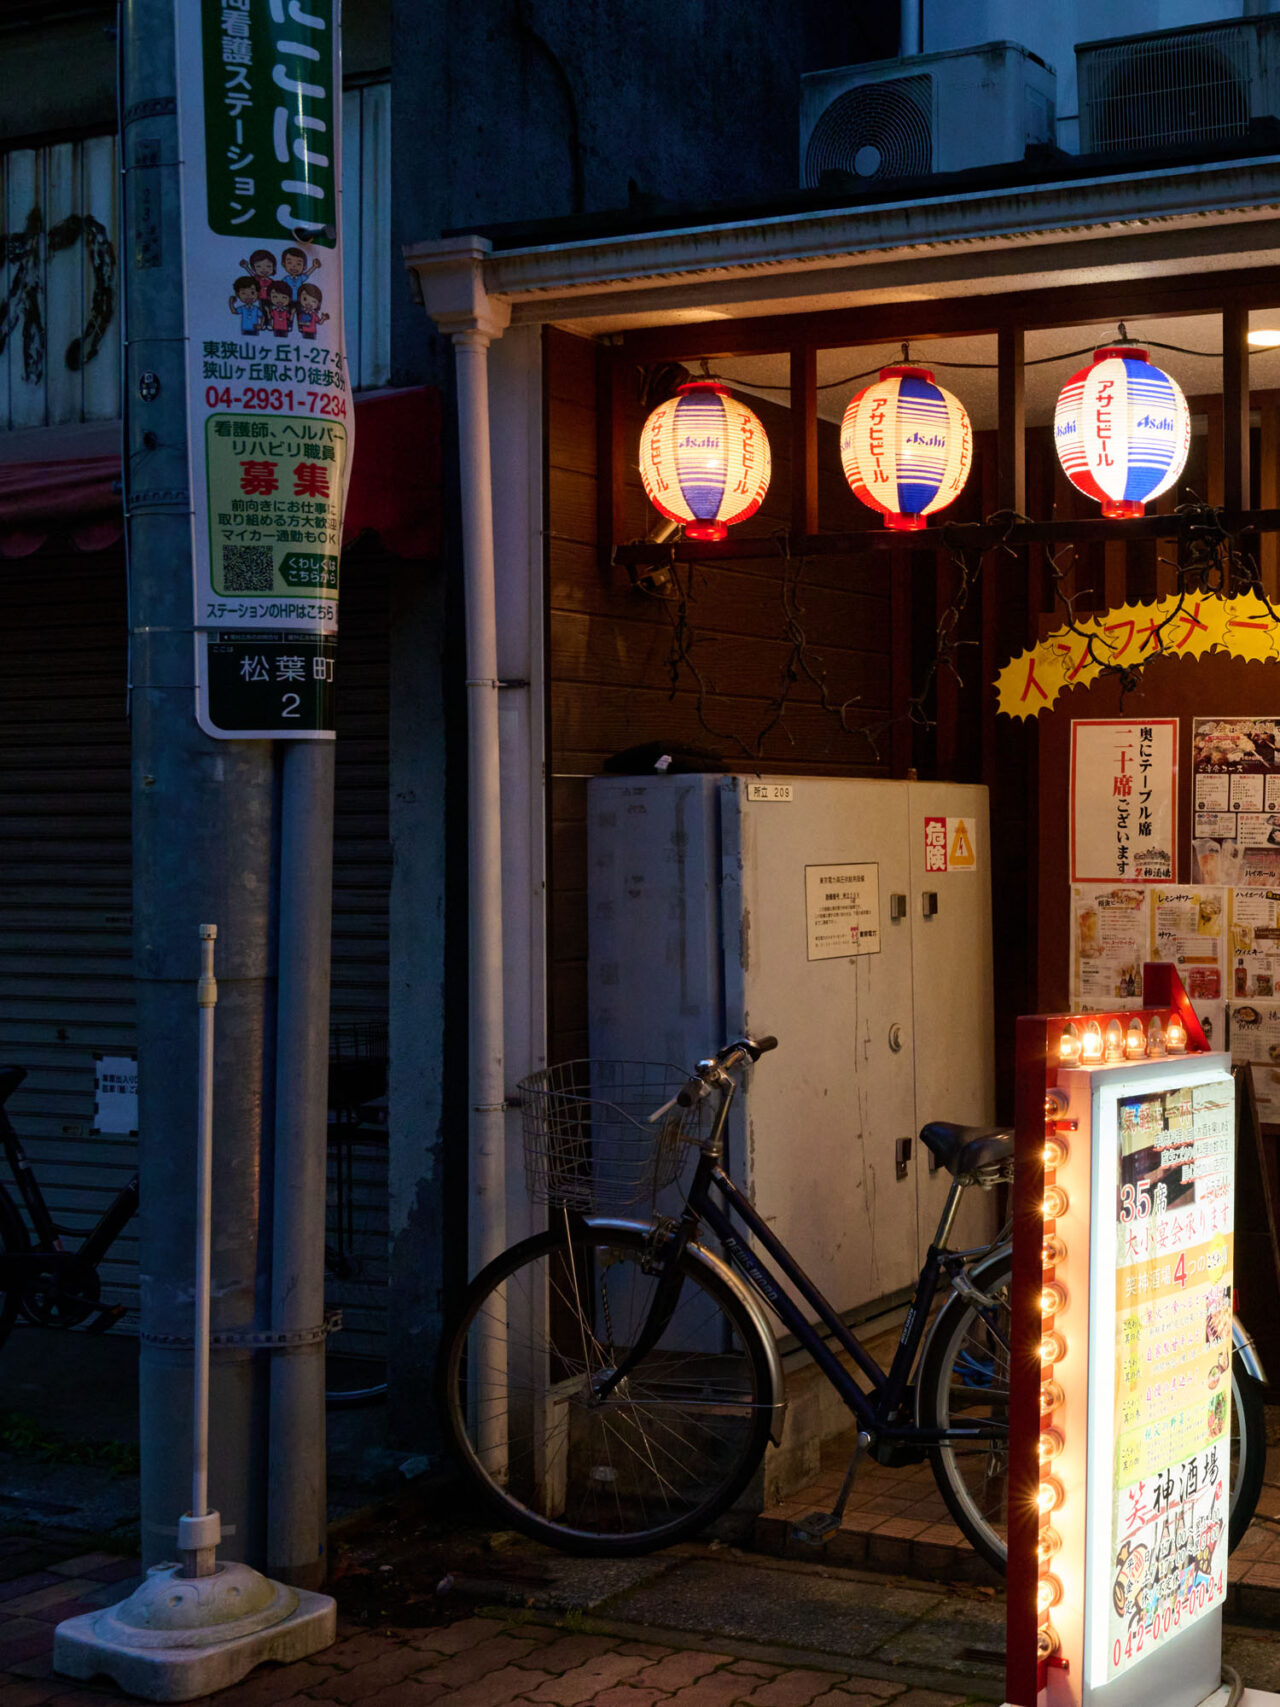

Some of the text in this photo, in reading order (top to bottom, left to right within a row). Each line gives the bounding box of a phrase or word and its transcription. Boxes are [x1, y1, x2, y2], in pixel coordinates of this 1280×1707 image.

[206, 386, 346, 419] 04-2931-7234
[215, 420, 344, 442] 看護師、ヘルパー
[1096, 380, 1114, 467] アサヒビール
[1136, 414, 1174, 432] Asahi
[232, 441, 337, 462] リハビリ職員
[679, 437, 720, 449] Asahi
[869, 398, 889, 484] アサヒビール
[906, 432, 946, 448] Asahi
[239, 461, 330, 499] 募集
[288, 557, 336, 570] くわしくは
[288, 569, 337, 584] こちらから
[207, 603, 334, 621] ステーションのHPはこちら
[239, 655, 336, 683] 松葉町
[281, 693, 302, 718] 2
[774, 786, 790, 799] 209
[1138, 727, 1153, 837] 奥にテーブル席
[926, 821, 946, 871] 危険
[1125, 1199, 1229, 1260] 大小宴会承ります
[1126, 1453, 1219, 1530] 笑神酒場
[1113, 1569, 1223, 1666] 042-003-0024
